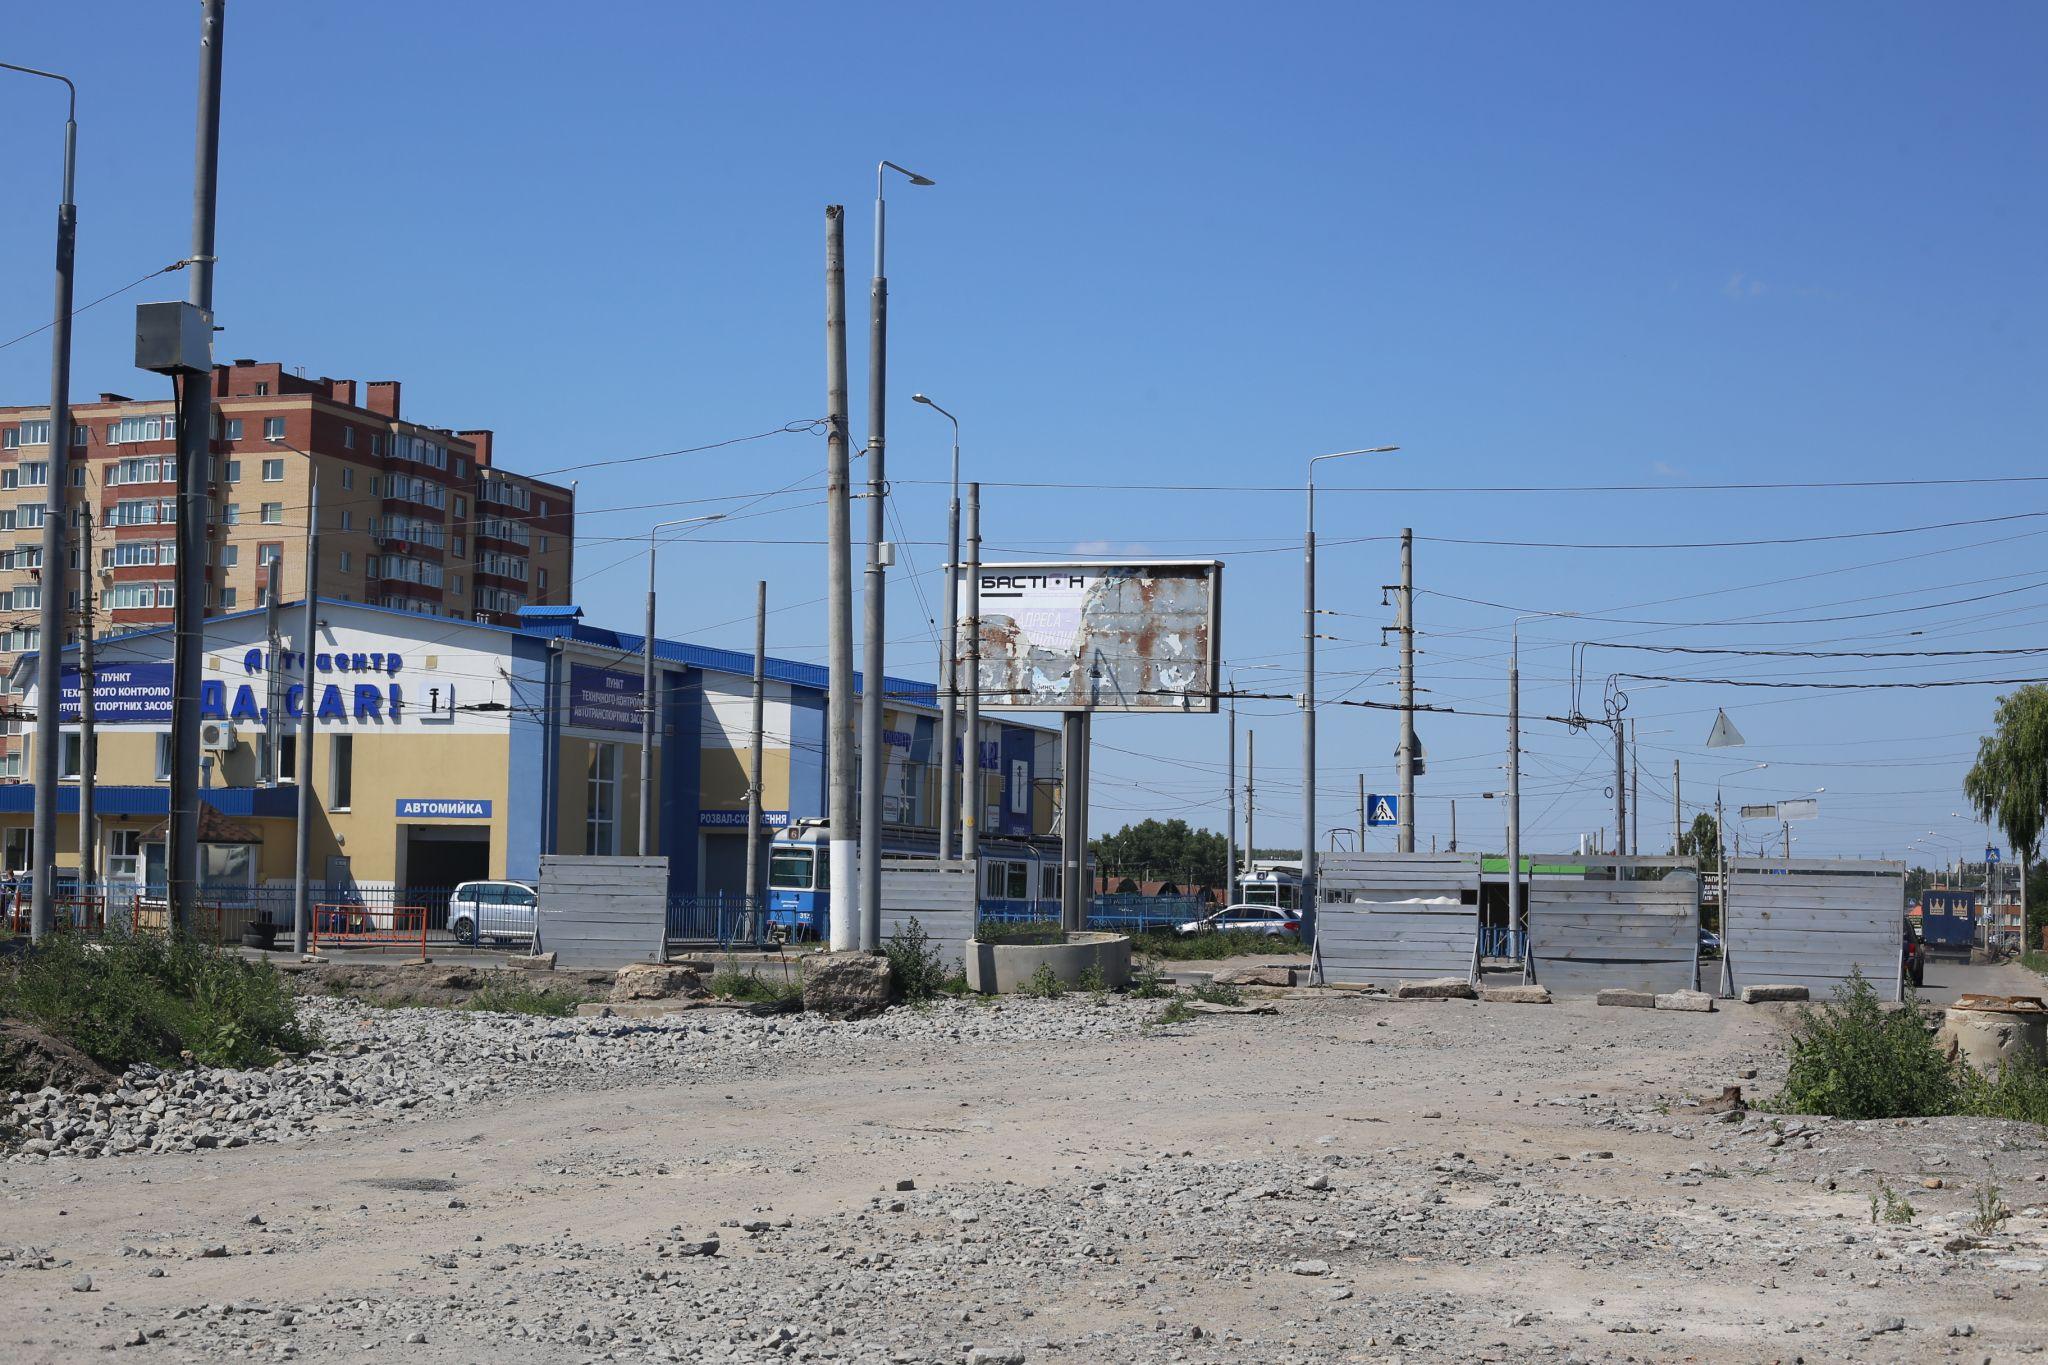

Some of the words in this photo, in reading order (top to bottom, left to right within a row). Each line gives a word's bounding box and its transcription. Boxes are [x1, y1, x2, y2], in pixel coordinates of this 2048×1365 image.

[101, 672, 131, 683] ПУНКТ
[62, 687, 117, 698] ТЕХНОГО
[118, 686, 170, 697] КОНТРОЛЮ
[404, 801, 483, 814] АВТОМИЙКА
